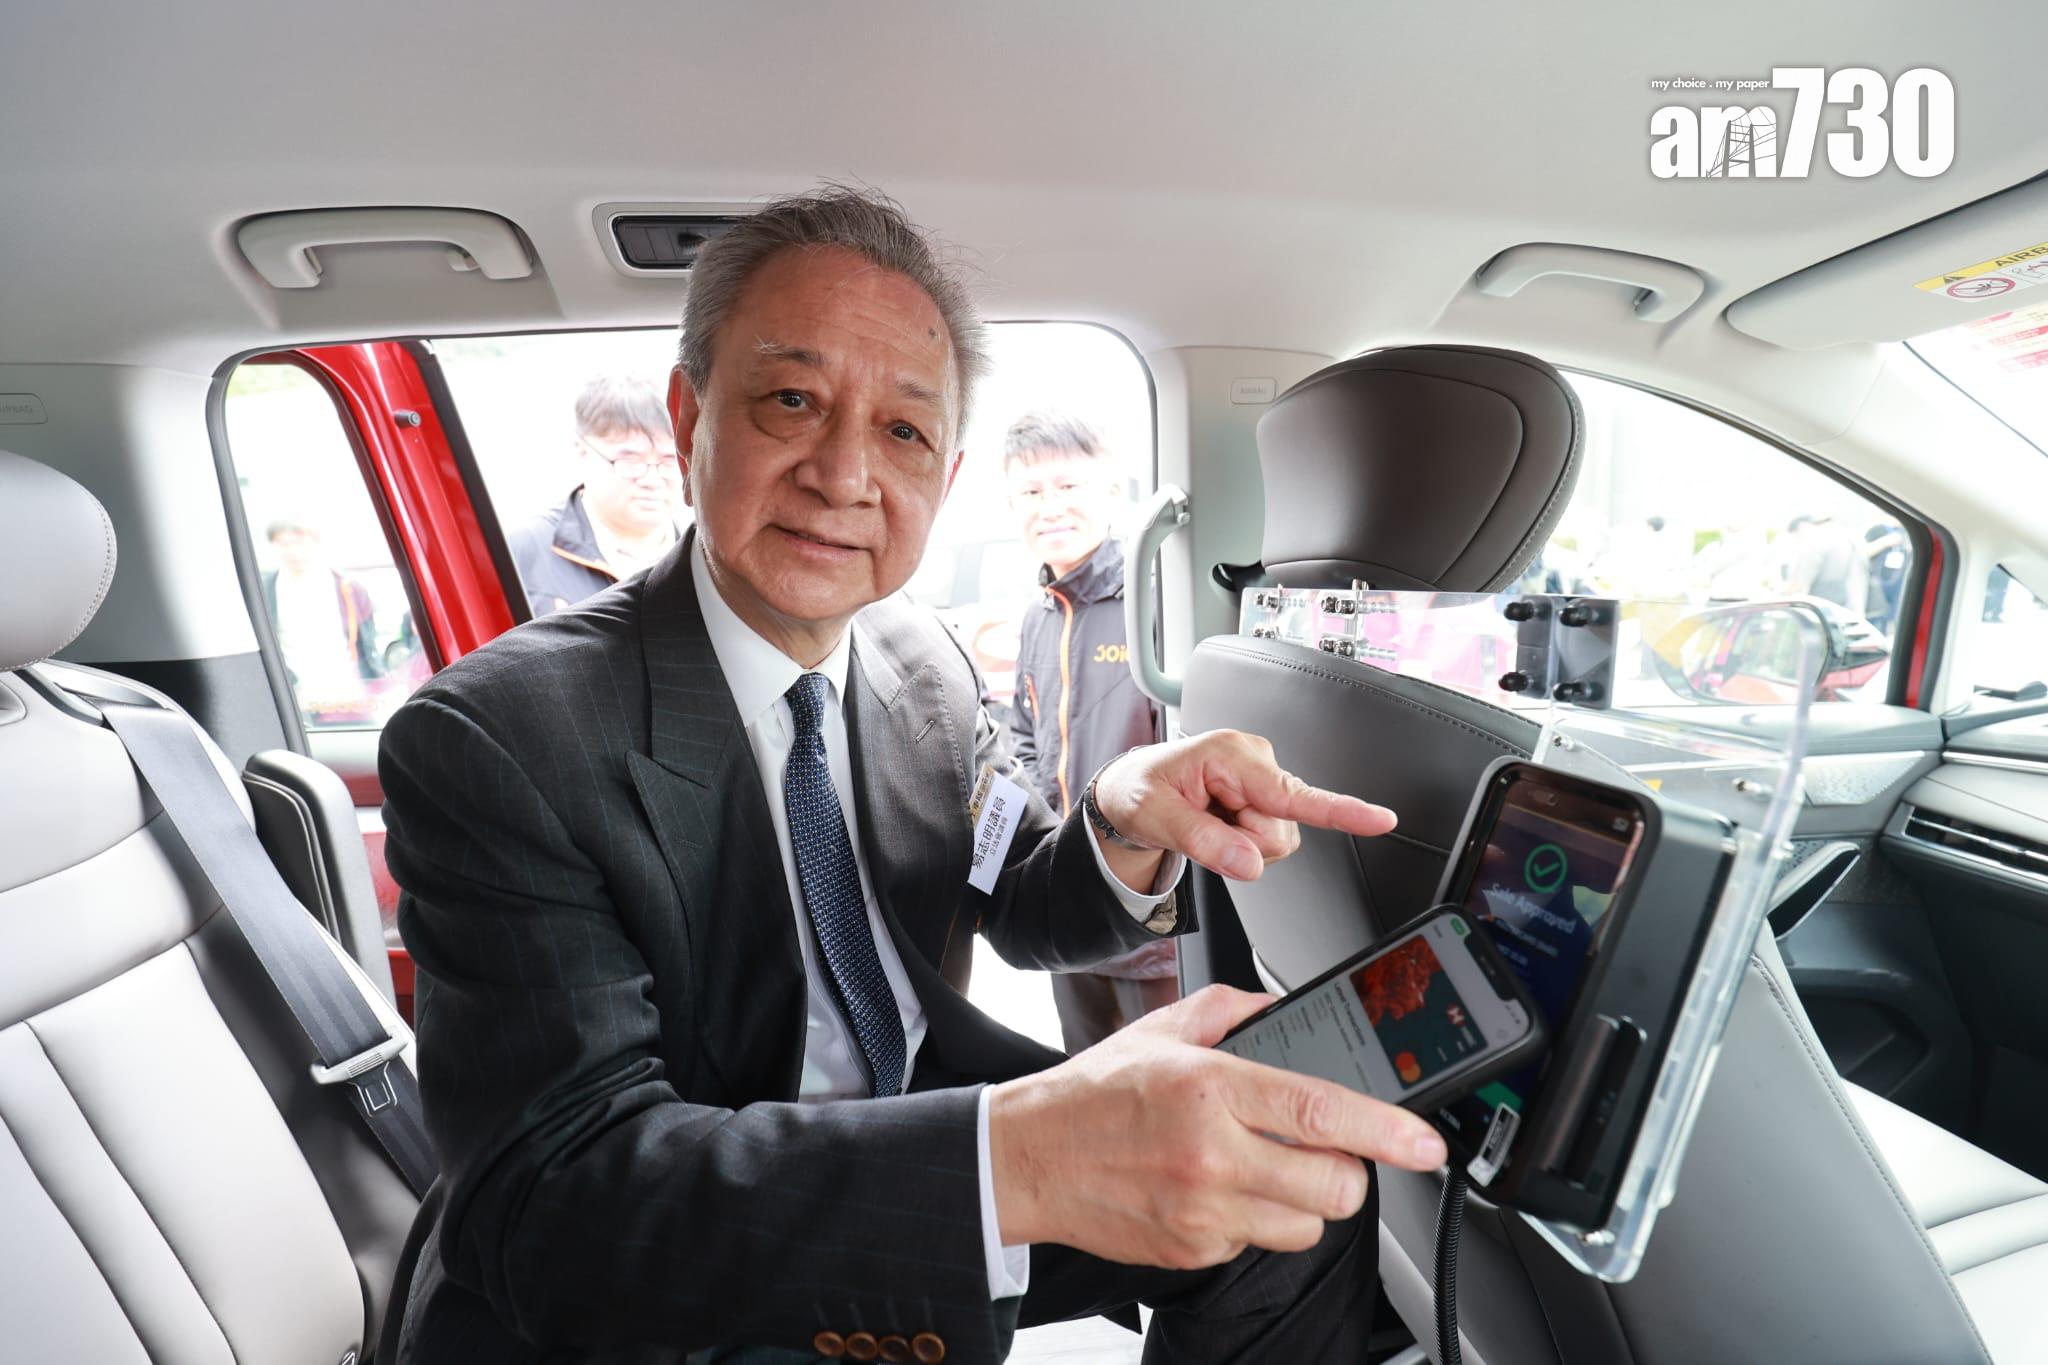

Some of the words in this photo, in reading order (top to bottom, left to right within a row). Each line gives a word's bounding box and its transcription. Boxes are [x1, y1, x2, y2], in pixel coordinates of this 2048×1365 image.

[972, 796, 1006, 869] 易志明議員
[1490, 883, 1515, 904] Sale
[1515, 896, 1577, 934] Approved
